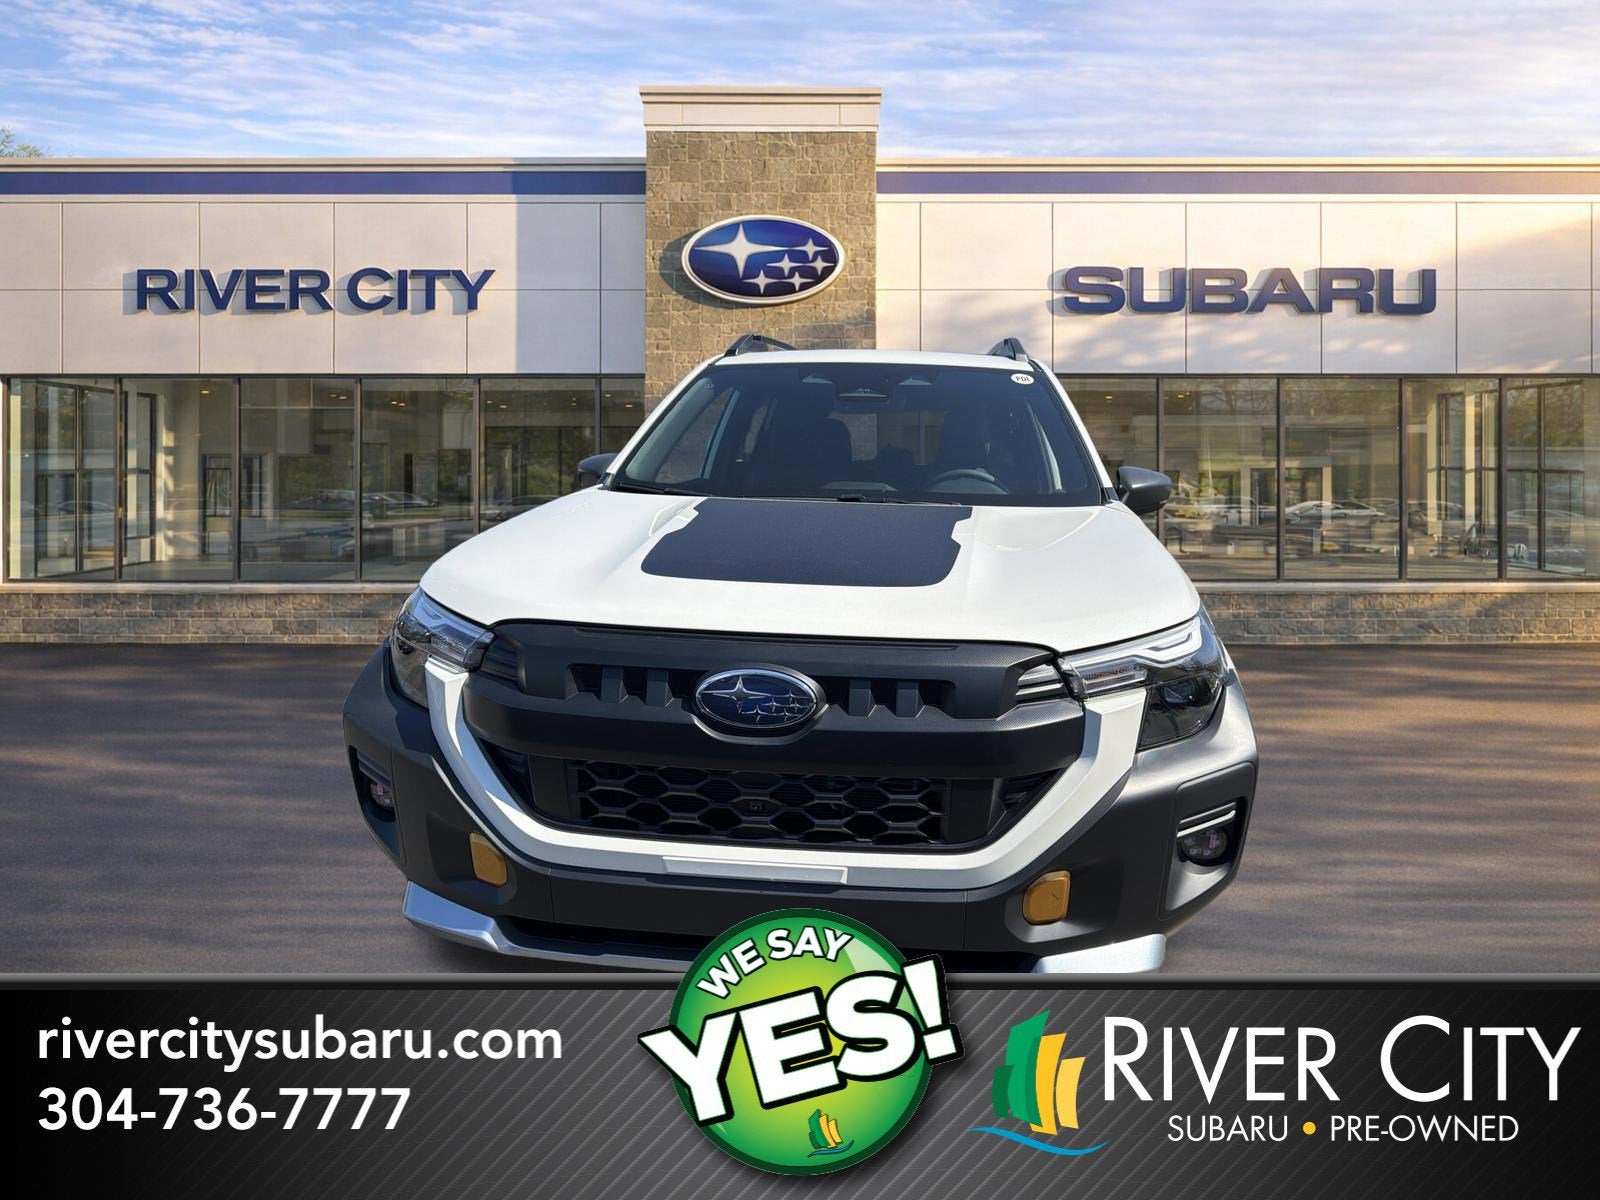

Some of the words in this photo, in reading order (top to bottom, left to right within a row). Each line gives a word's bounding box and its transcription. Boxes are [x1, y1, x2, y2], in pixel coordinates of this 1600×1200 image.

[136, 268, 334, 311] RIVER
[346, 267, 496, 311] CITY
[1063, 266, 1437, 315] SUBARU
